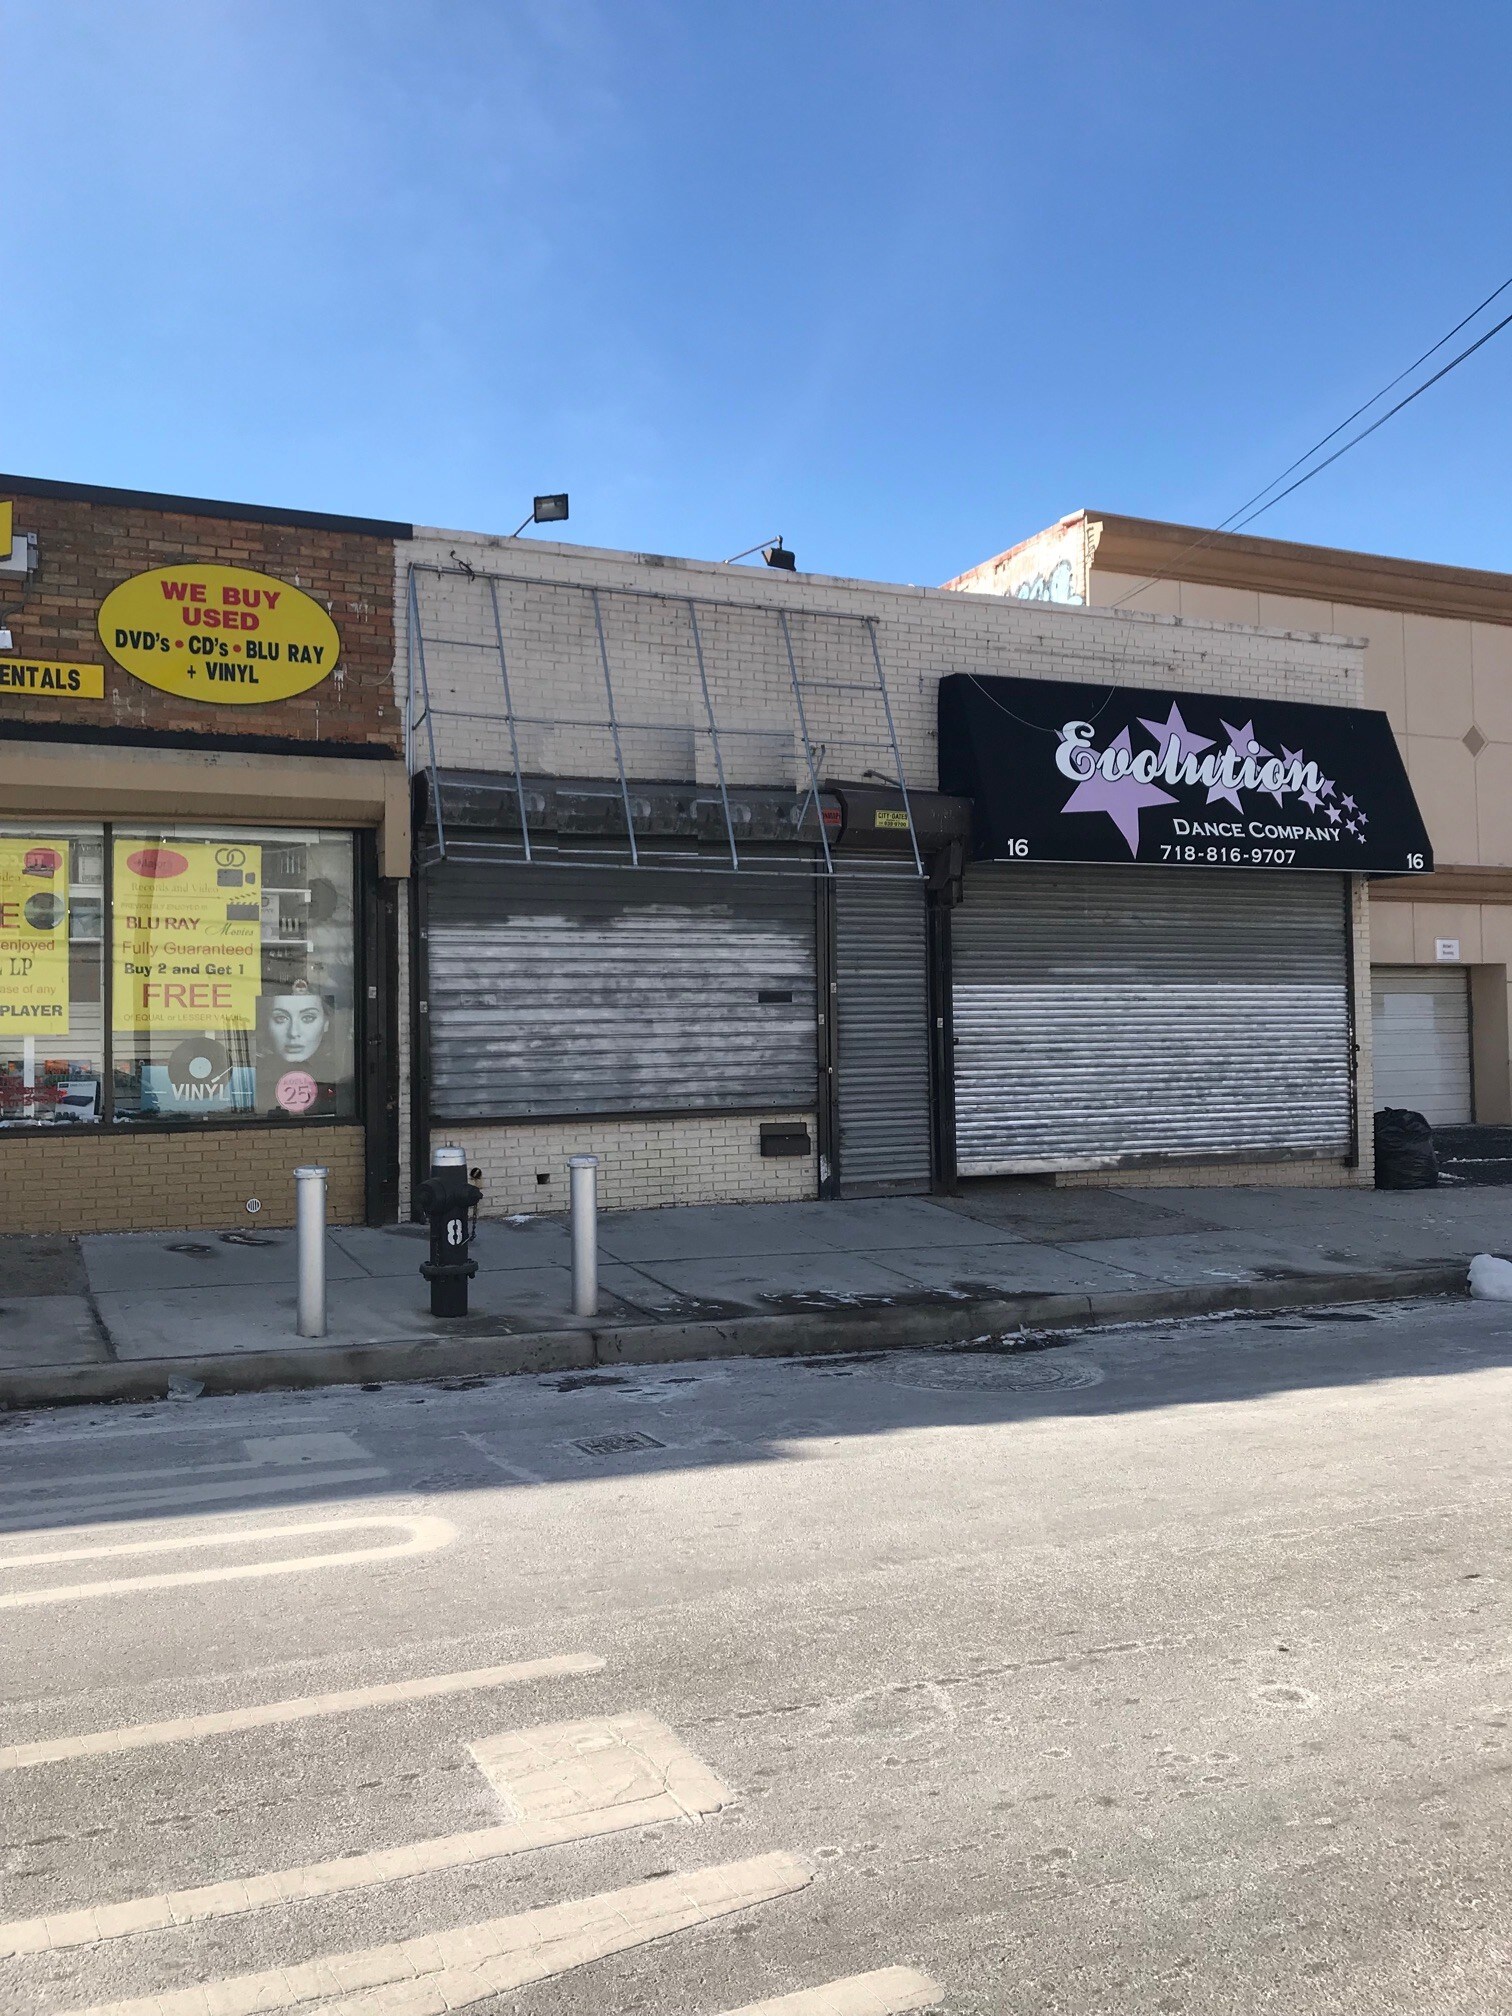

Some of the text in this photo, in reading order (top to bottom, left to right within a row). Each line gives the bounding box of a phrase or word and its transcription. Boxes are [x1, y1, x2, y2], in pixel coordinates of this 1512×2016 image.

[161, 581, 281, 610] WE BUY
[182, 607, 260, 631] USED
[115, 629, 324, 664] DVD's CD's BLU RAY
[0, 664, 81, 691] ENTALS
[206, 662, 259, 684] VINYL
[1054, 721, 1326, 793] Evolution
[1172, 818, 1342, 843] DANCE COMPANY
[1007, 838, 1029, 857] 16
[1160, 845, 1296, 865] 718-816-9707
[1406, 853, 1424, 869] 16
[126, 916, 200, 930] BLU RAY
[204, 922, 254, 937] Movies
[1, 939, 55, 953] enjoyed
[122, 941, 253, 957] Fully Guaranteed
[10, 957, 33, 976] LP
[124, 962, 245, 977] Buy 2 and Get 1
[23, 984, 34, 994] of
[36, 986, 57, 996] any
[142, 983, 233, 1009] FREE
[0, 1004, 63, 1017] PLAYER
[135, 1013, 164, 1021] EQUAL
[171, 1083, 230, 1102] VINYL
[284, 1085, 312, 1105] 25
